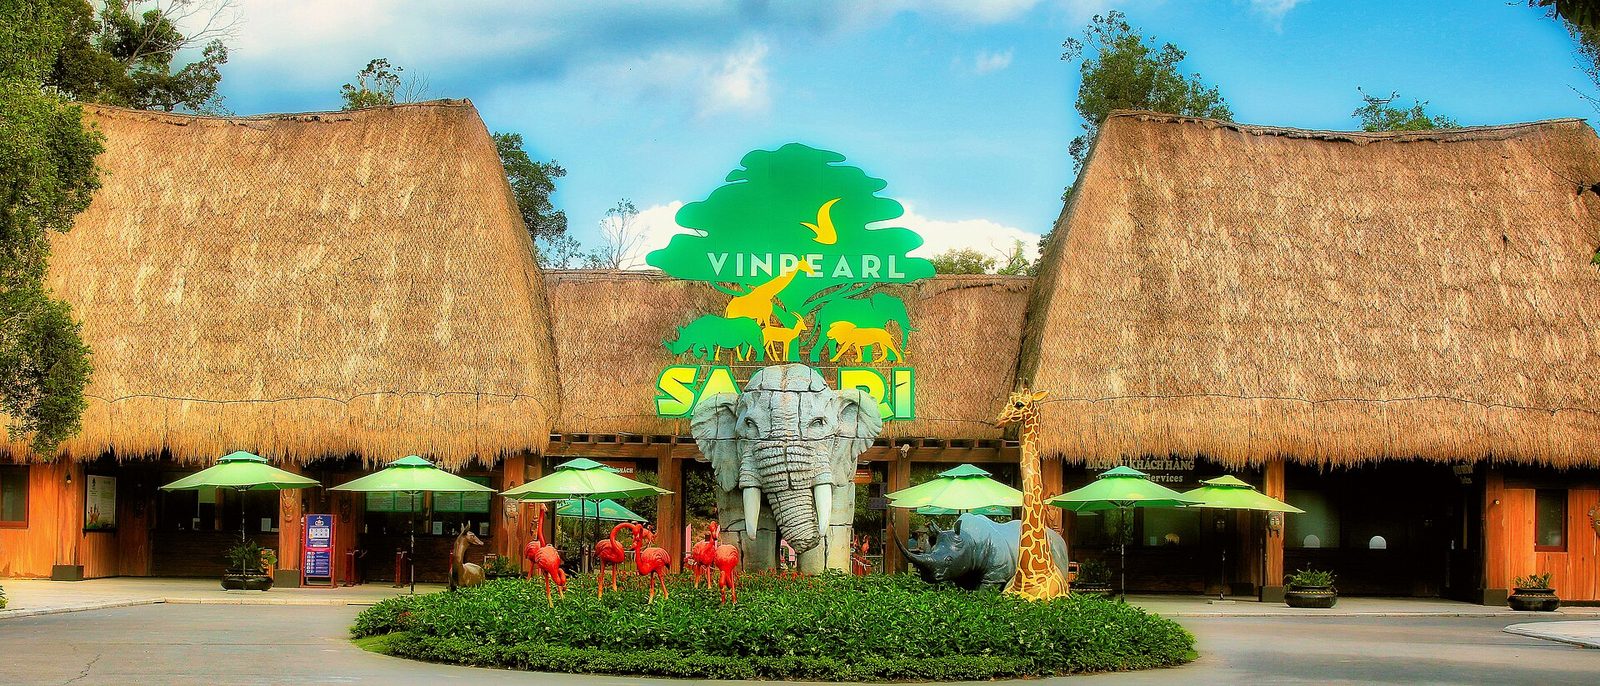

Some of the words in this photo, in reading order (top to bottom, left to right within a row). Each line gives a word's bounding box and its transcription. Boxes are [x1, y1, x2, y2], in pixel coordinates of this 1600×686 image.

[707, 252, 905, 279] VINPEARL
[655, 365, 915, 421] SARI
[1165, 457, 1195, 471] HÀNG
